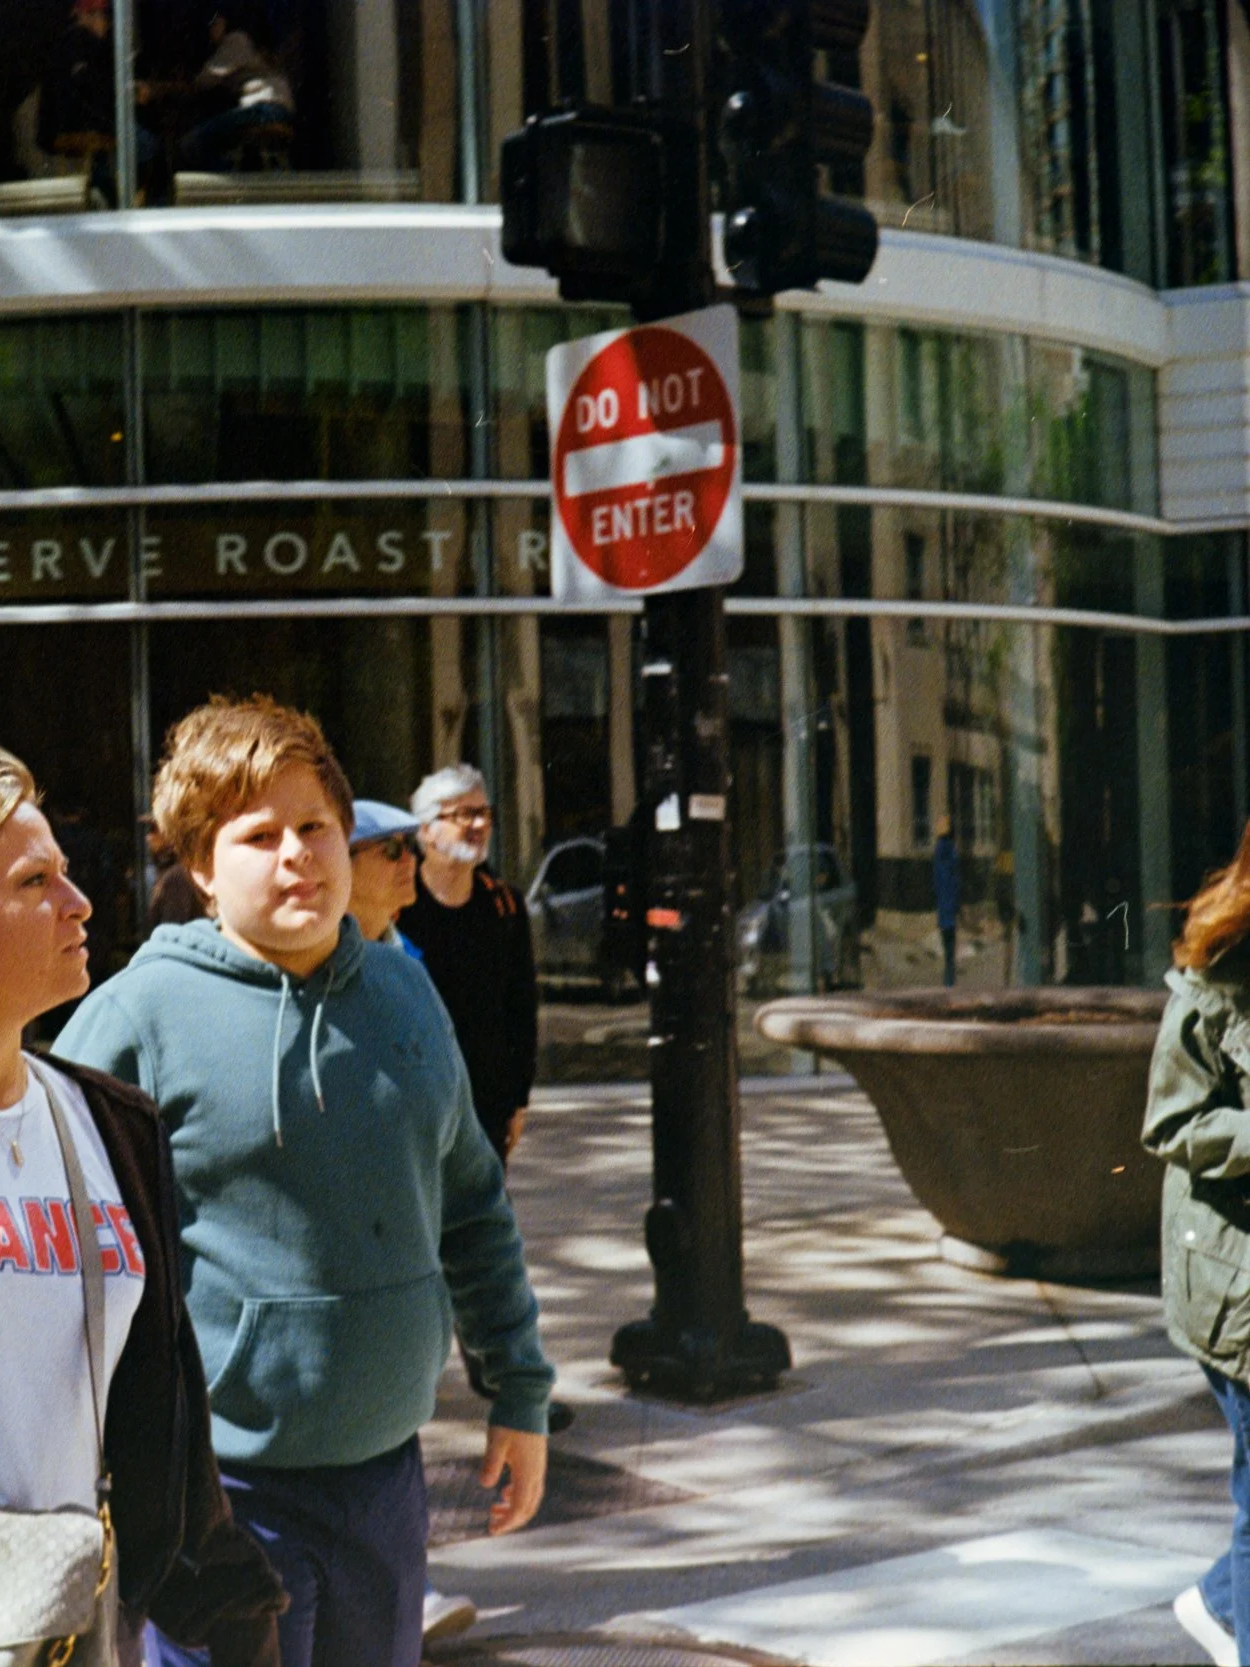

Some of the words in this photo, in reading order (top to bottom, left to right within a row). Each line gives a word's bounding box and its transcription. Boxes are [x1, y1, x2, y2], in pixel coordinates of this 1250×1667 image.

[576, 387, 619, 433] DO
[638, 368, 703, 420] NOT
[591, 490, 695, 546] ENTER
[215, 529, 547, 576] ROASTR
